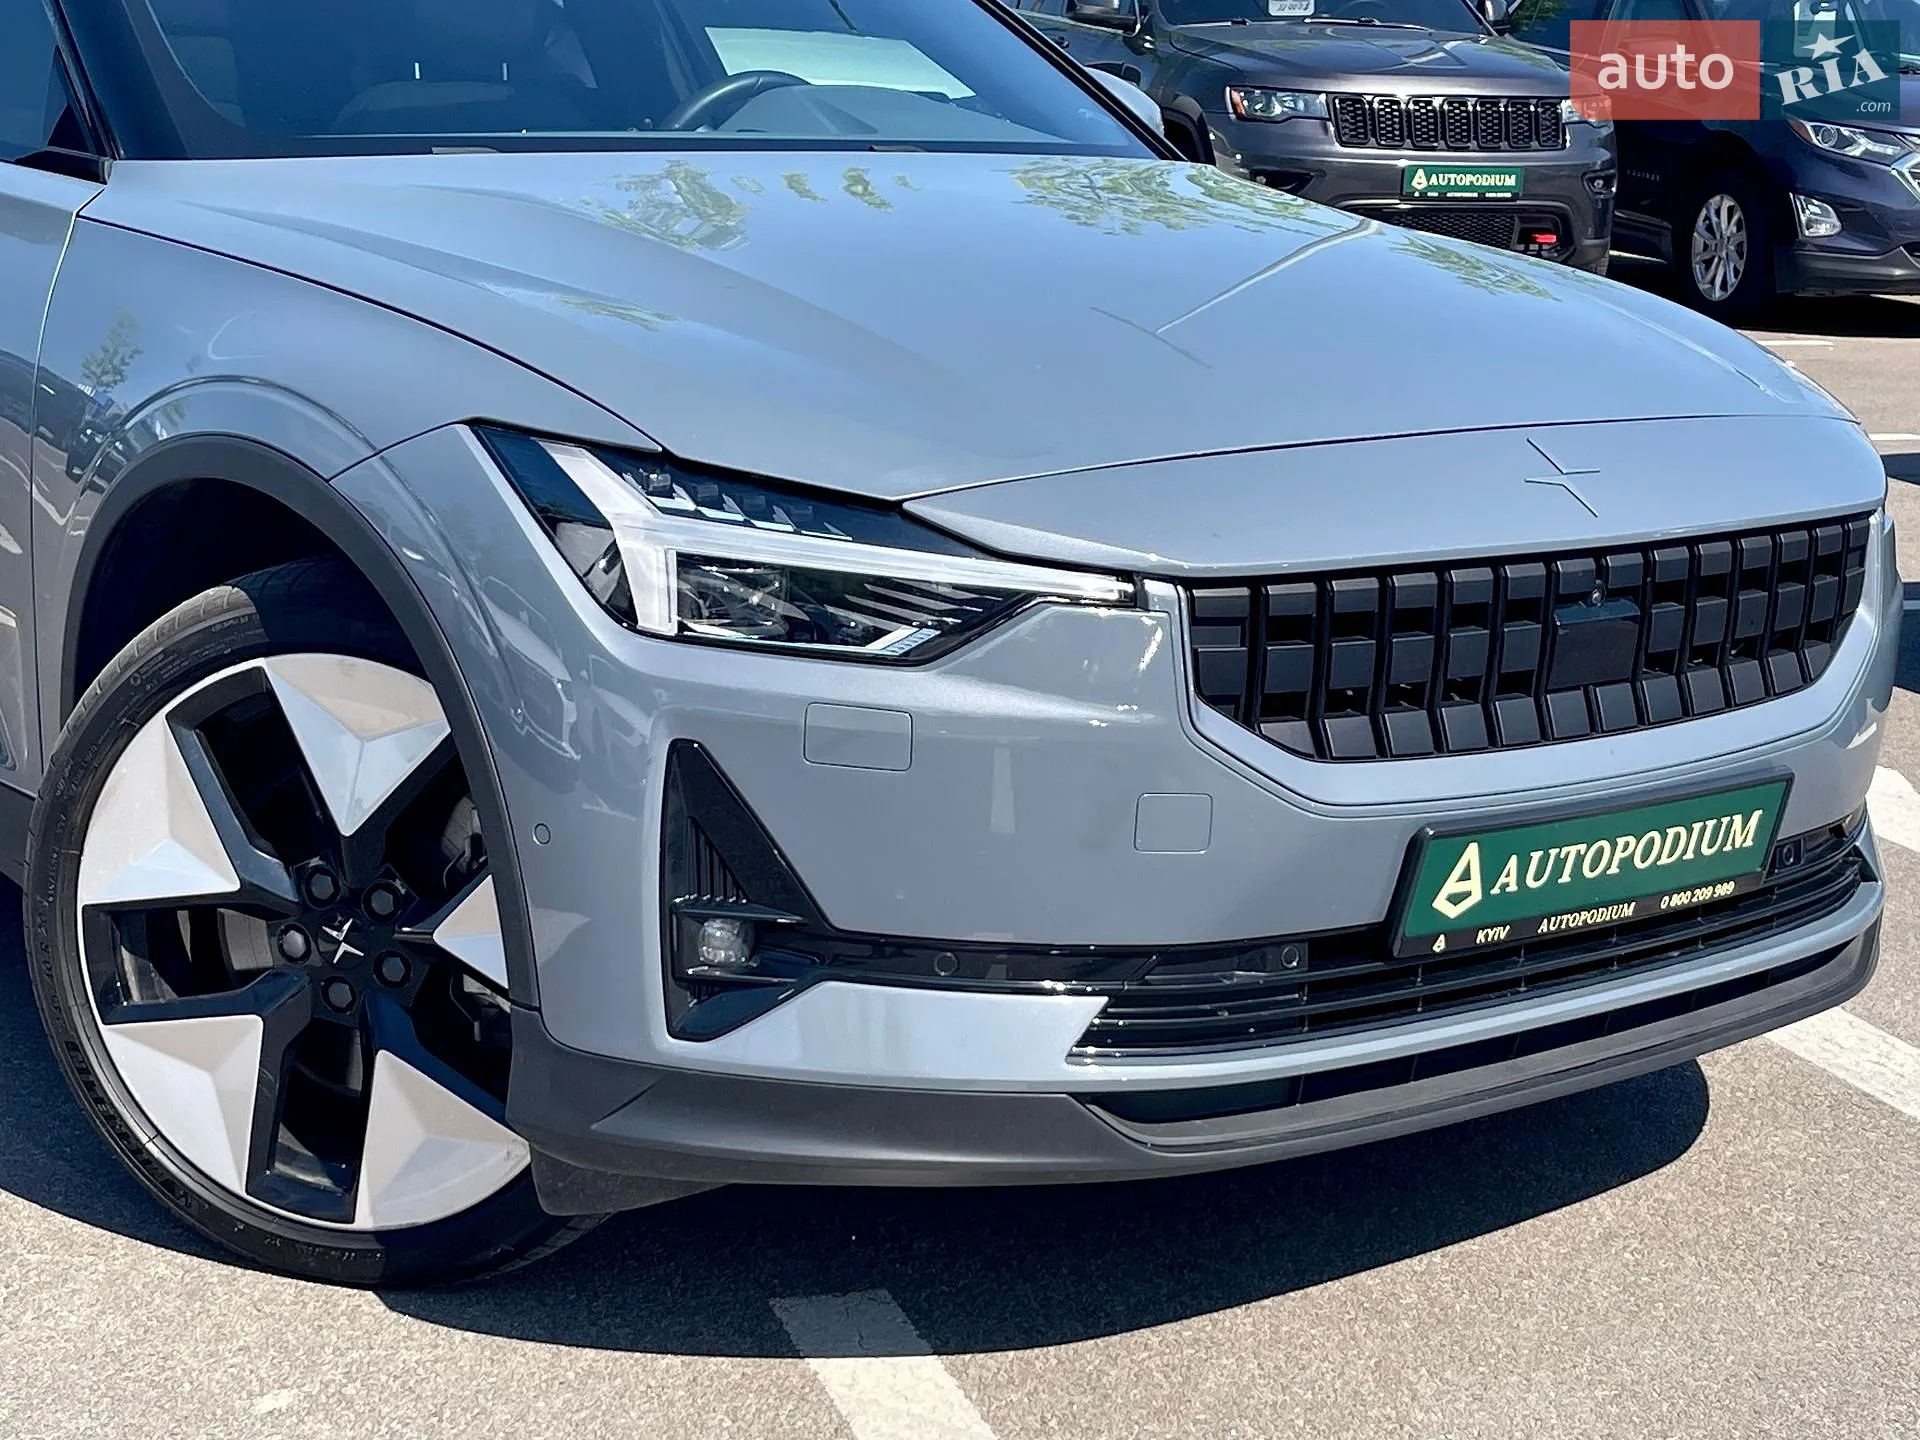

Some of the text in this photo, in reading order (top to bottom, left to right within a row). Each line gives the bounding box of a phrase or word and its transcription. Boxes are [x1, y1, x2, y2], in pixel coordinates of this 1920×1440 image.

[1428, 173, 1517, 187] AUTOPODIUM
[1489, 809, 1763, 895] AUTOPODIUM
[1476, 925, 1511, 945] KYIV
[1537, 902, 1637, 934] AUTOPODIUM
